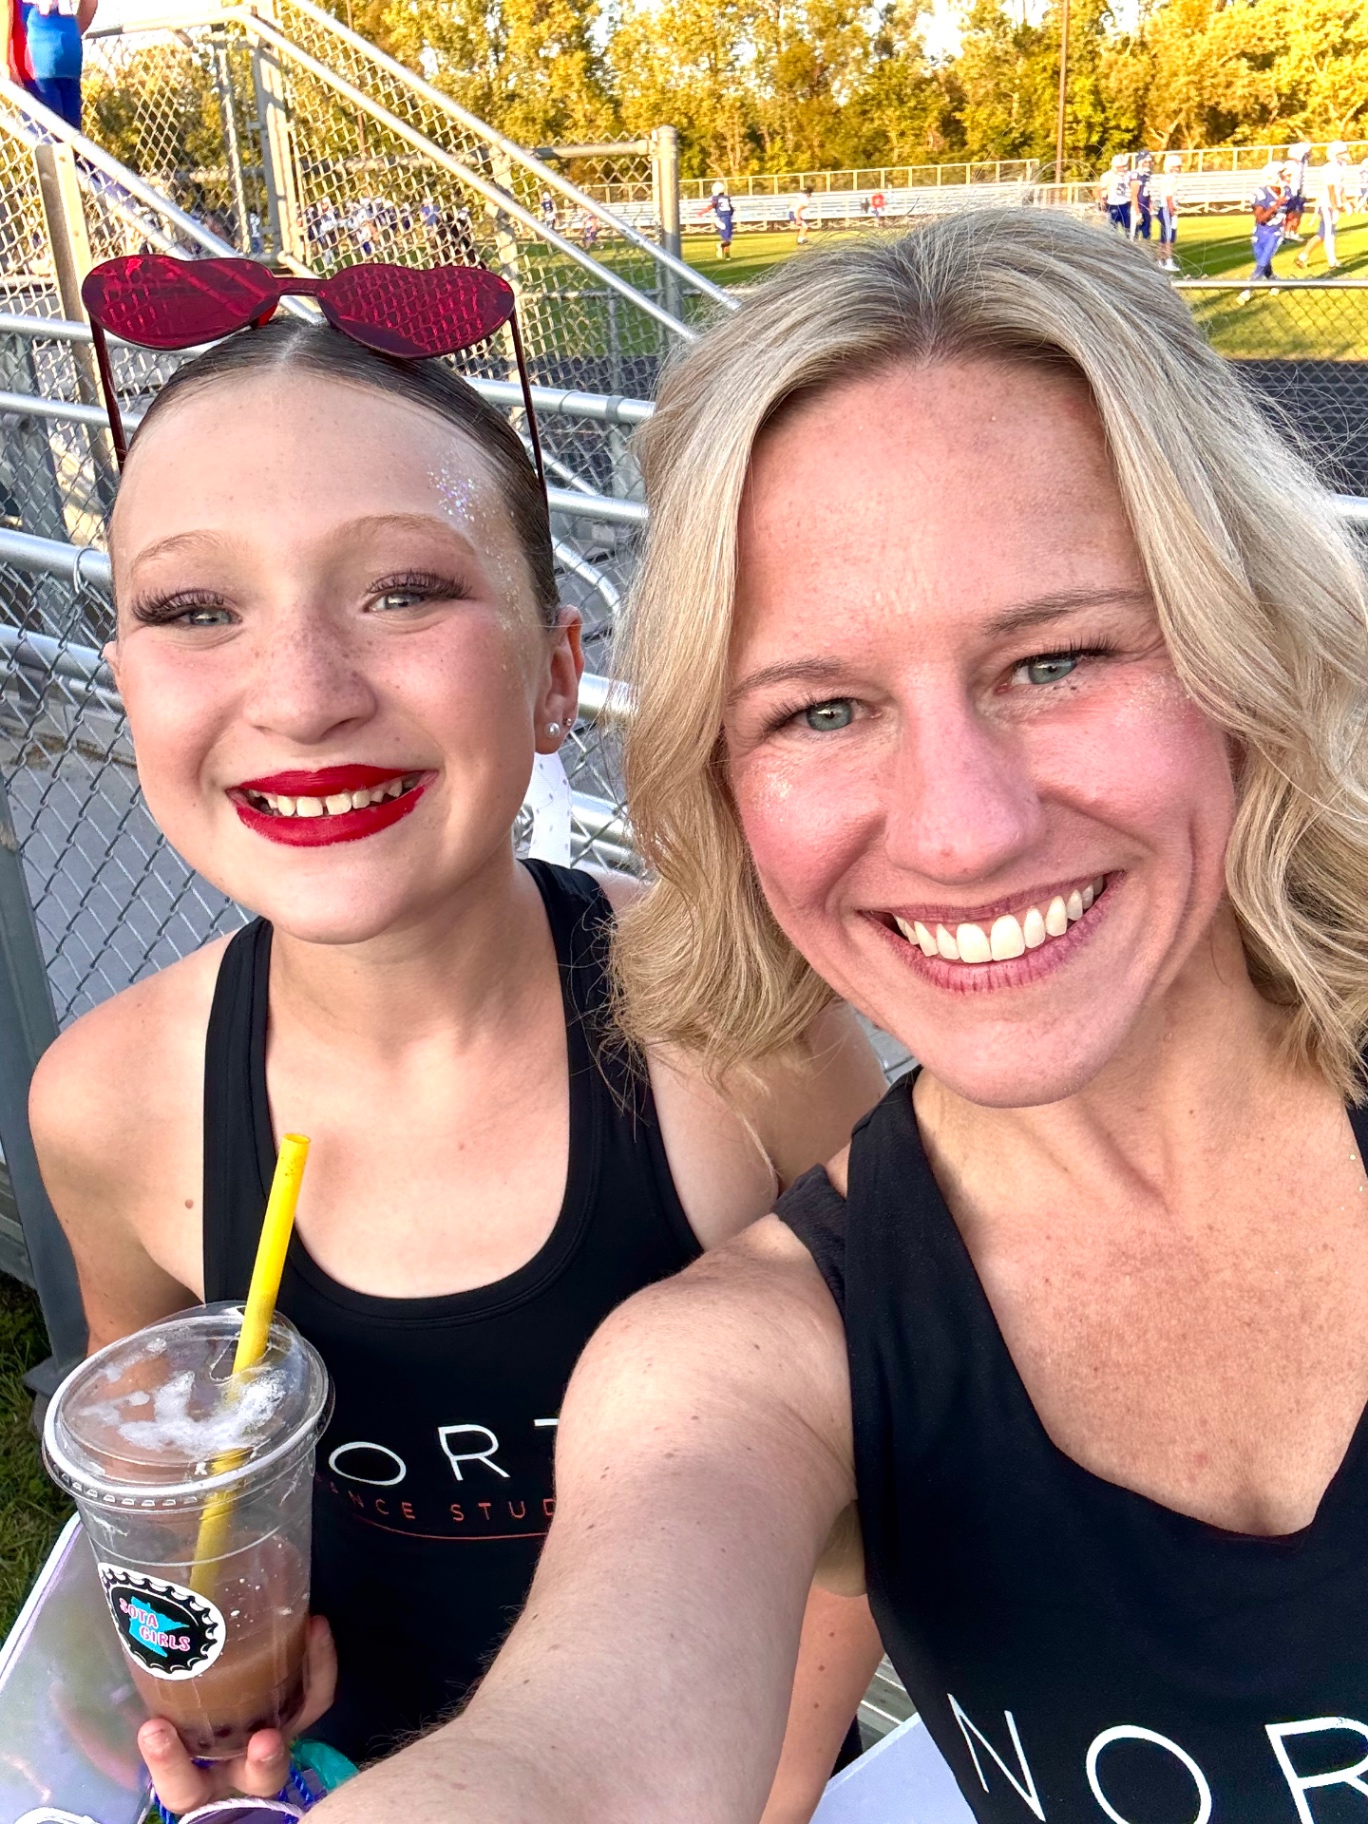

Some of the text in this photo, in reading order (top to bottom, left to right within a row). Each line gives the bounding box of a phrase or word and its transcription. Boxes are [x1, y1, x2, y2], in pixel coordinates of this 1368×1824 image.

[119, 1597, 158, 1629] SOTA
[139, 1625, 191, 1652] GIRLS
[947, 1692, 1368, 1824] NOR
